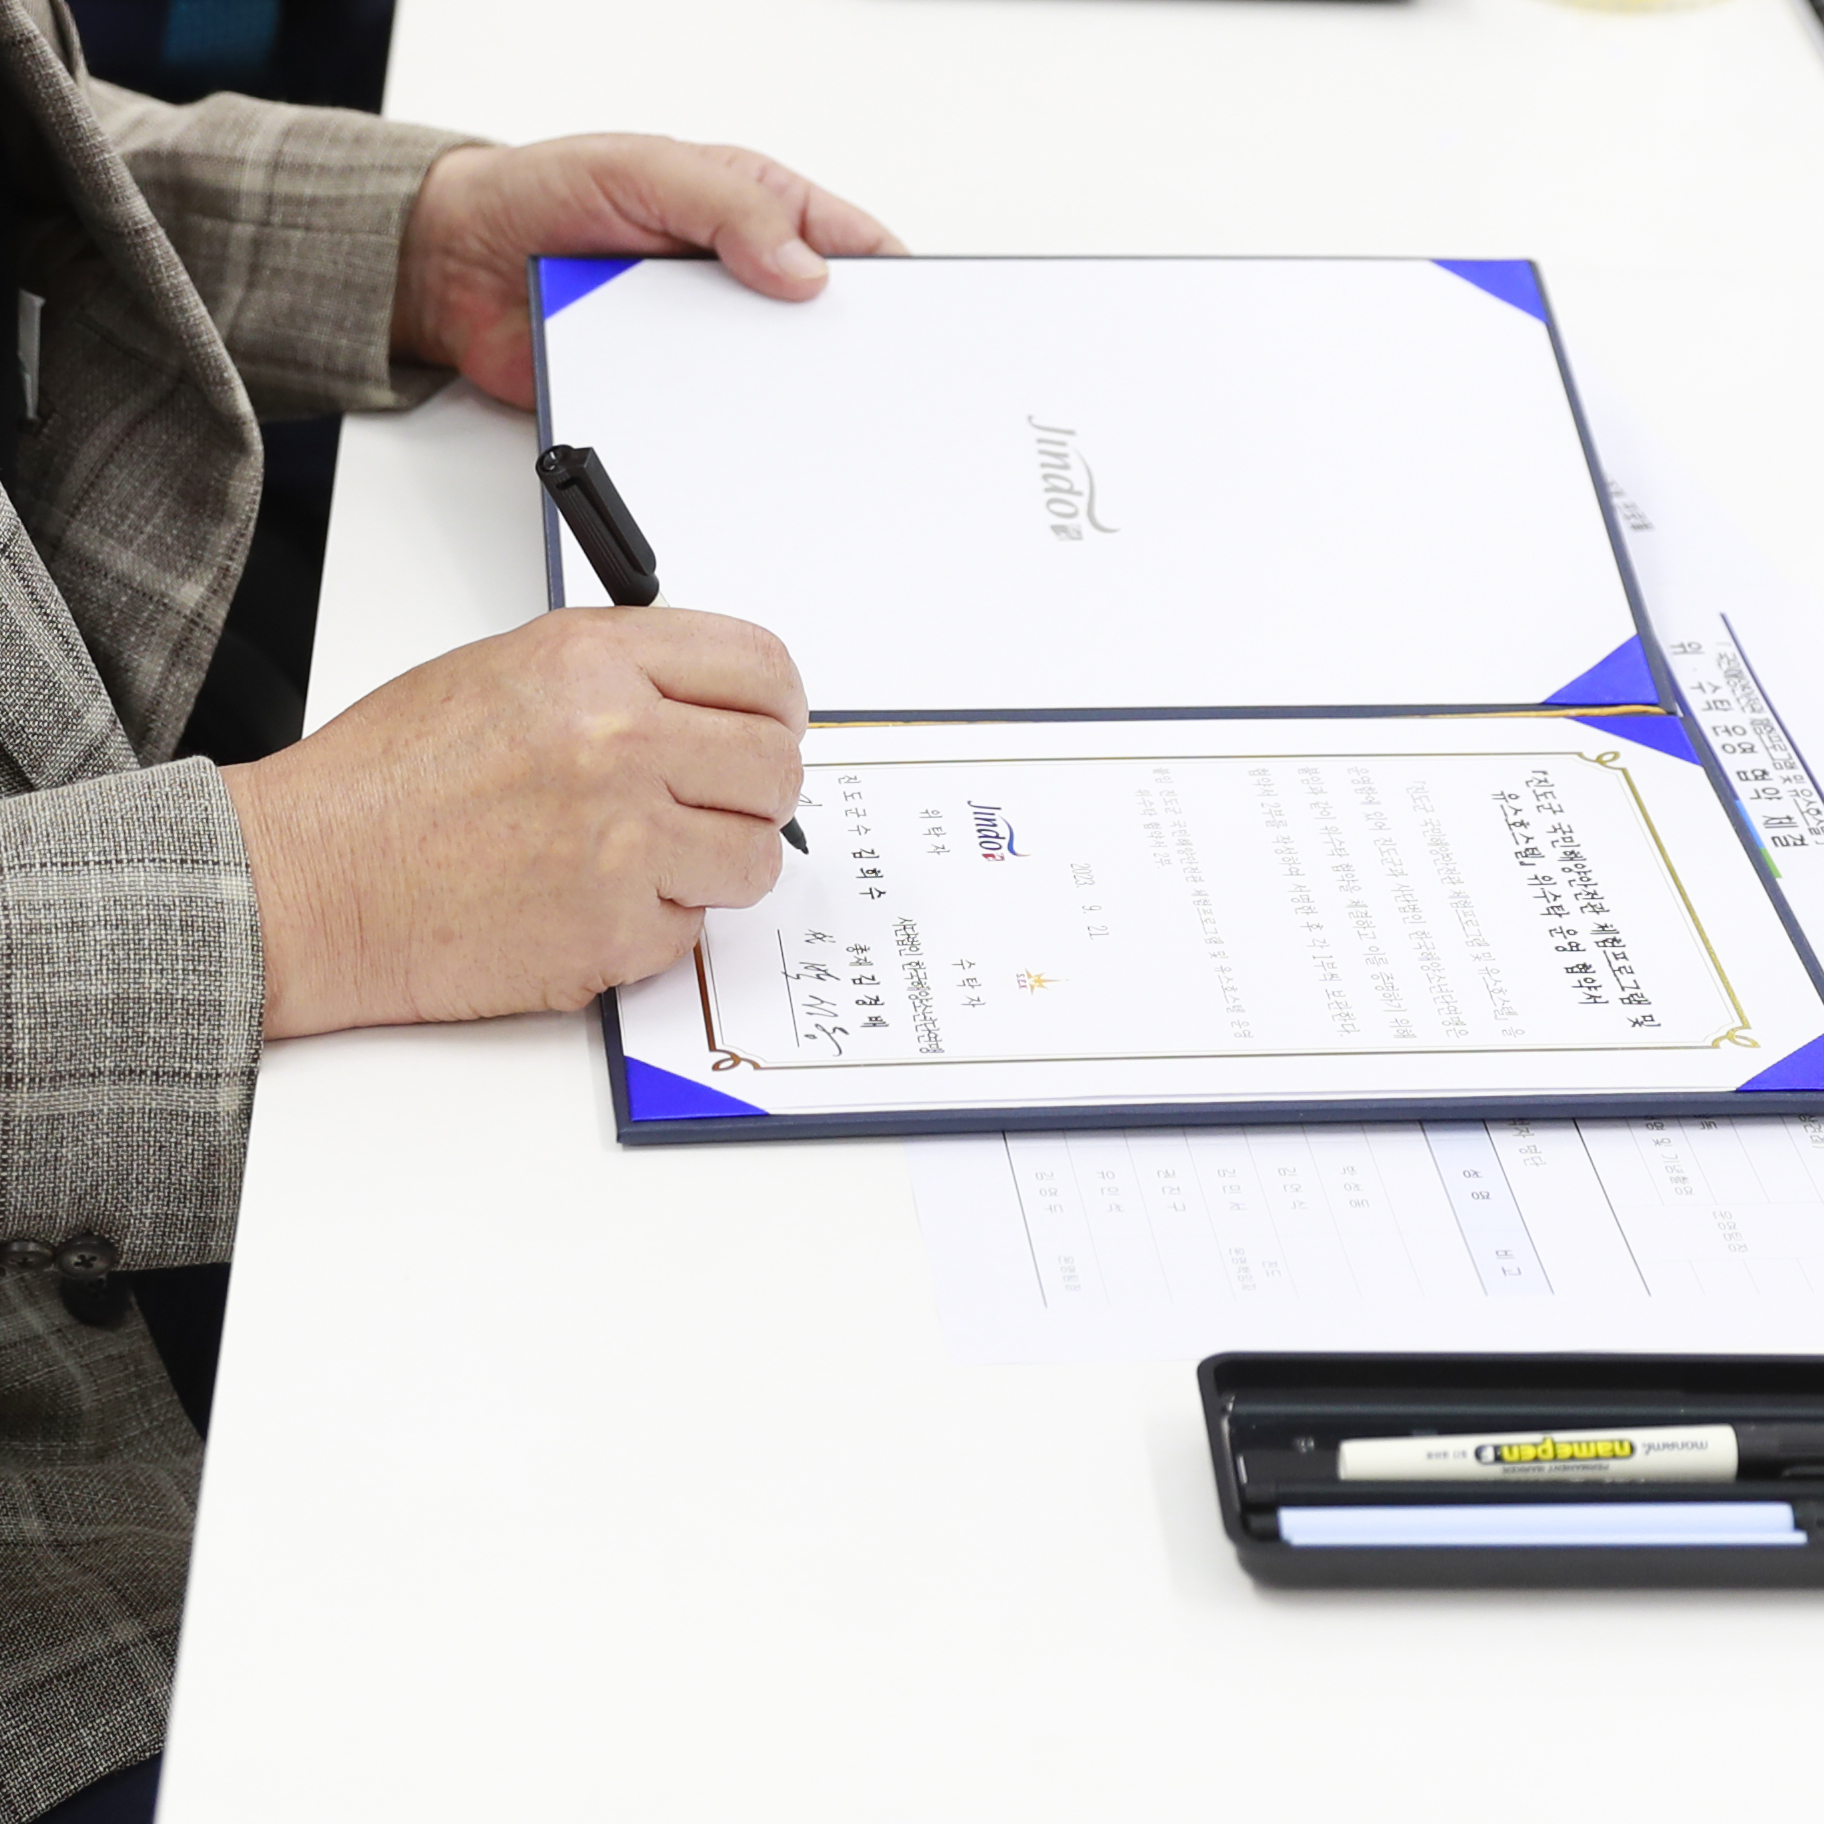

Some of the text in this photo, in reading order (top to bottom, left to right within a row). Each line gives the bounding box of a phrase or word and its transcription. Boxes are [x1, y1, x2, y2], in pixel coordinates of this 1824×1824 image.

[1026, 414, 1084, 520] Jindo
[1347, 766, 1381, 806] 운영함에
[1711, 725, 1758, 755] 운영
[1735, 768, 1782, 801] 협약
[1761, 814, 1809, 848] 체결
[1779, 775, 1805, 784] 및
[1158, 789, 1182, 815] 진도군
[1362, 811, 1391, 831] 있어
[967, 800, 1006, 852] Jindo
[1134, 789, 1173, 869] 위수탁 협약서 2부.
[1070, 863, 1095, 888] 2023.
[1373, 837, 1407, 877] 진도군과
[1081, 905, 1103, 914] 9.
[1248, 768, 1360, 1037] 협약서 2부를 작성하여 서명한 후 각 1부씩 보관한다.
[1298, 767, 1417, 1039] 붙임과 같이 위수탁 협약을 체결하고 이를 증명하기 위해
[1390, 883, 1426, 924] 사단법인
[1420, 817, 1464, 885] 국민해양안전관
[1450, 890, 1490, 947] 체험프로그램
[1470, 952, 1496, 962] 및
[1526, 874, 1570, 918] 위수탁
[1191, 888, 1224, 944] 체험프로그램
[1545, 822, 1609, 914] 국민해양안전관
[1590, 922, 1652, 1006] 체험프로그램
[1627, 1014, 1662, 1028] 및
[846, 943, 873, 967] 총재
[1209, 951, 1229, 959] 및
[1548, 926, 1586, 952] 운영
[892, 917, 944, 1054] 사단법인 한국해양소년단연맹
[1214, 964, 1246, 1013] 유스호스텔
[1563, 962, 1609, 1005] 협약서
[1231, 1019, 1254, 1039] 운영
[1519, 1145, 1546, 1167] 명단
[1712, 1211, 1749, 1253] 운영팀장
[1500, 1437, 1632, 1464] namepen
